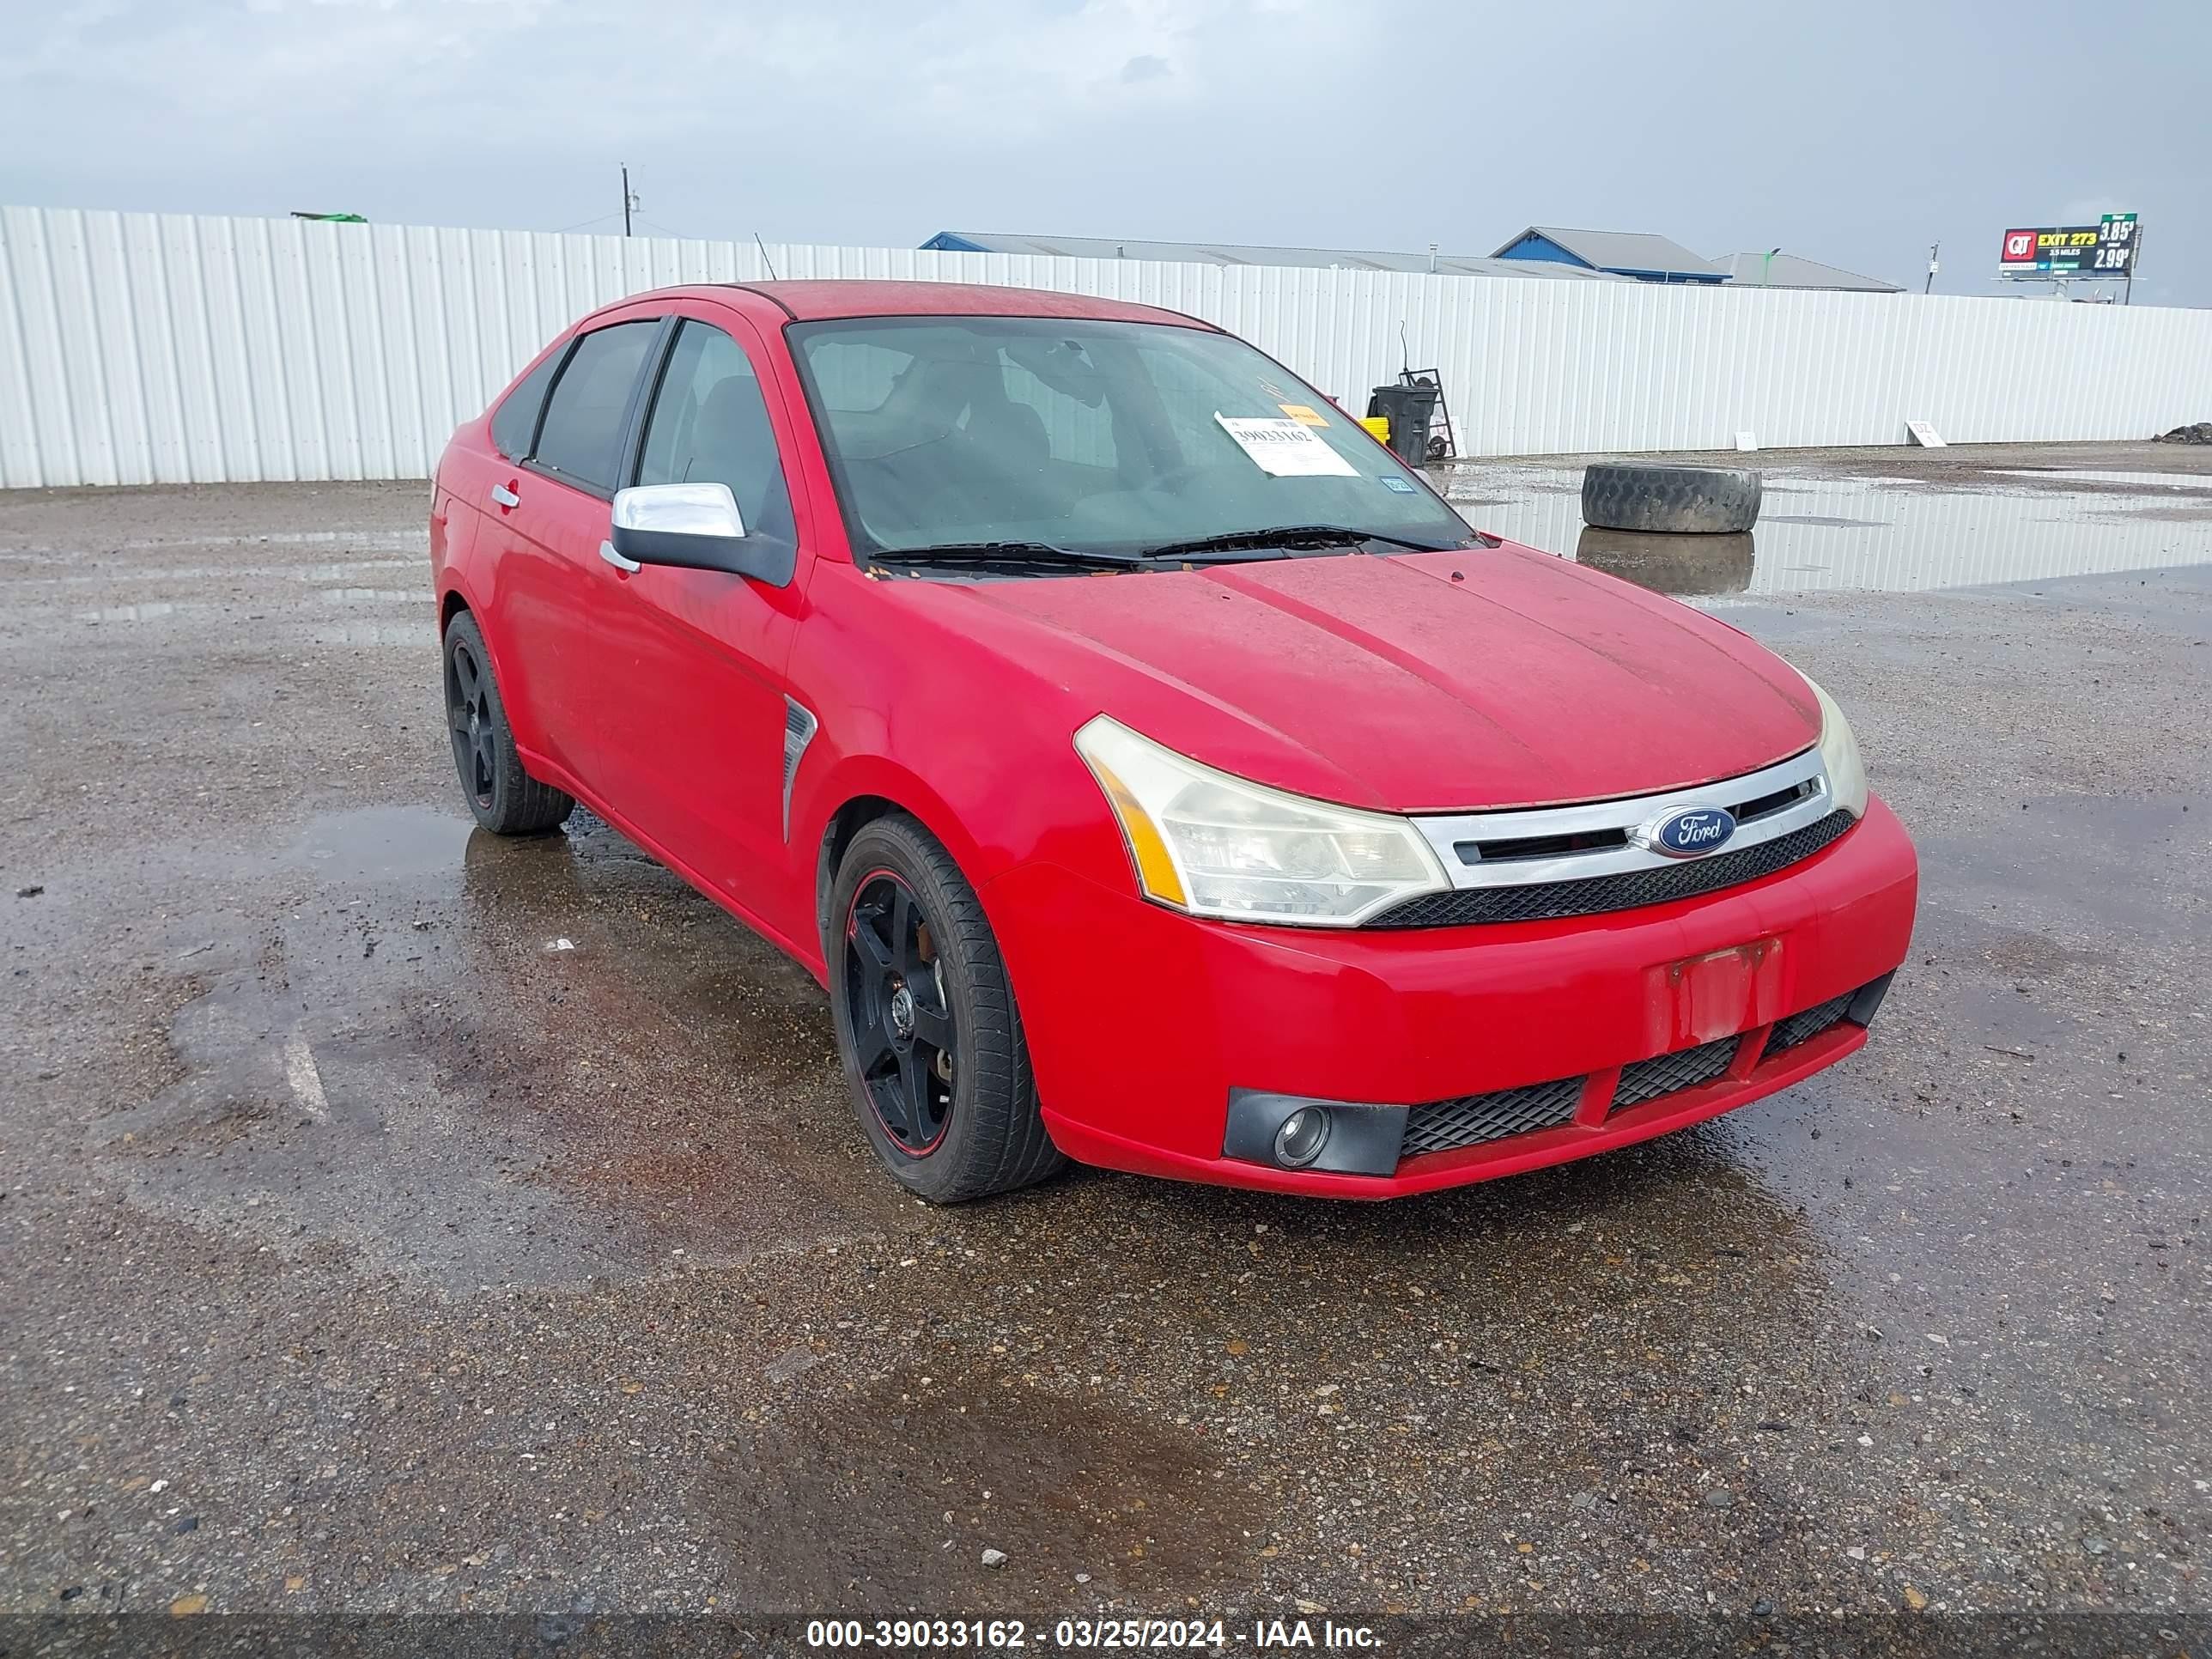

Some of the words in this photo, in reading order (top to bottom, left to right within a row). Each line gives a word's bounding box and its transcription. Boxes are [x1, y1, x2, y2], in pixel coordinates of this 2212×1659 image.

[2008, 235, 2033, 256] QT
[2037, 233, 2069, 246] EXIT
[2069, 232, 2097, 246] 273
[1678, 814, 1723, 846] Ford
